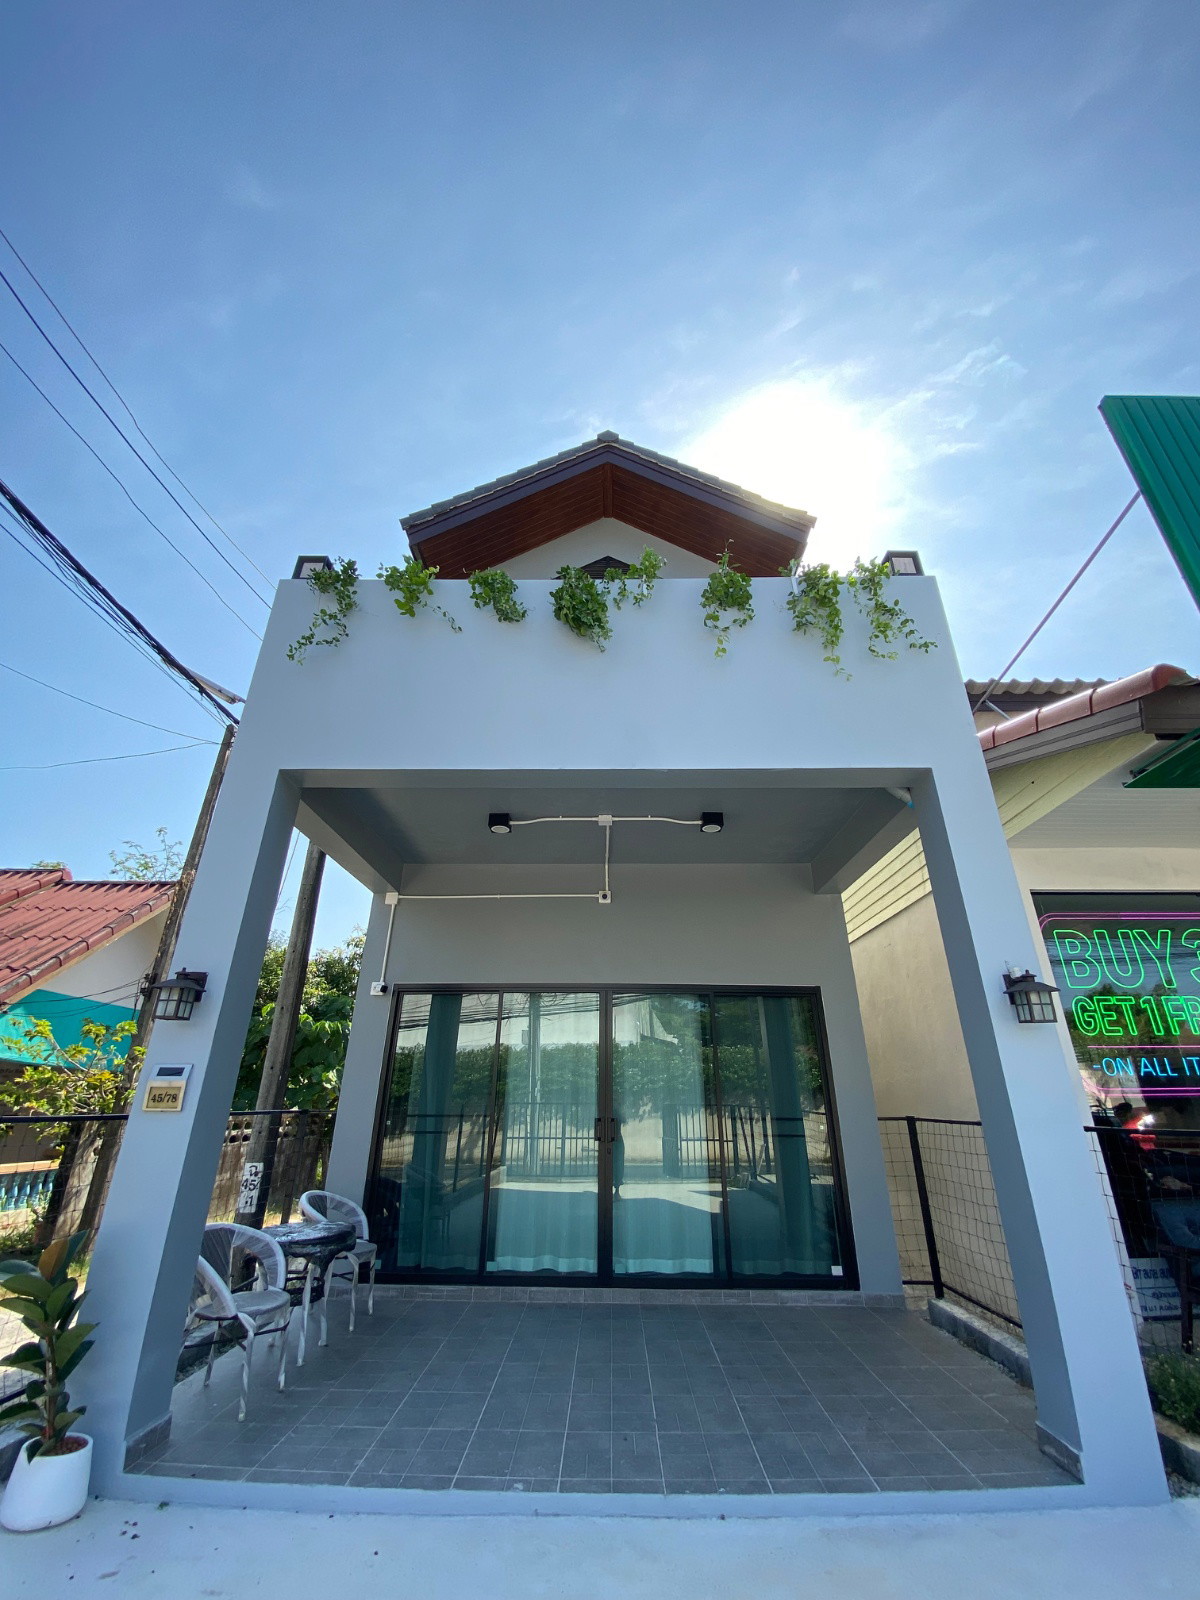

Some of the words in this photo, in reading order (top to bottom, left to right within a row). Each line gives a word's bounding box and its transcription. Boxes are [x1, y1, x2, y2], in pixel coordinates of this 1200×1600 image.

[1053, 929, 1177, 988] BUY
[1072, 996, 1138, 1036] GET
[1140, 996, 1165, 1036] 1
[1141, 1057, 1178, 1077] ALL
[150, 1091, 178, 1103] 45/78
